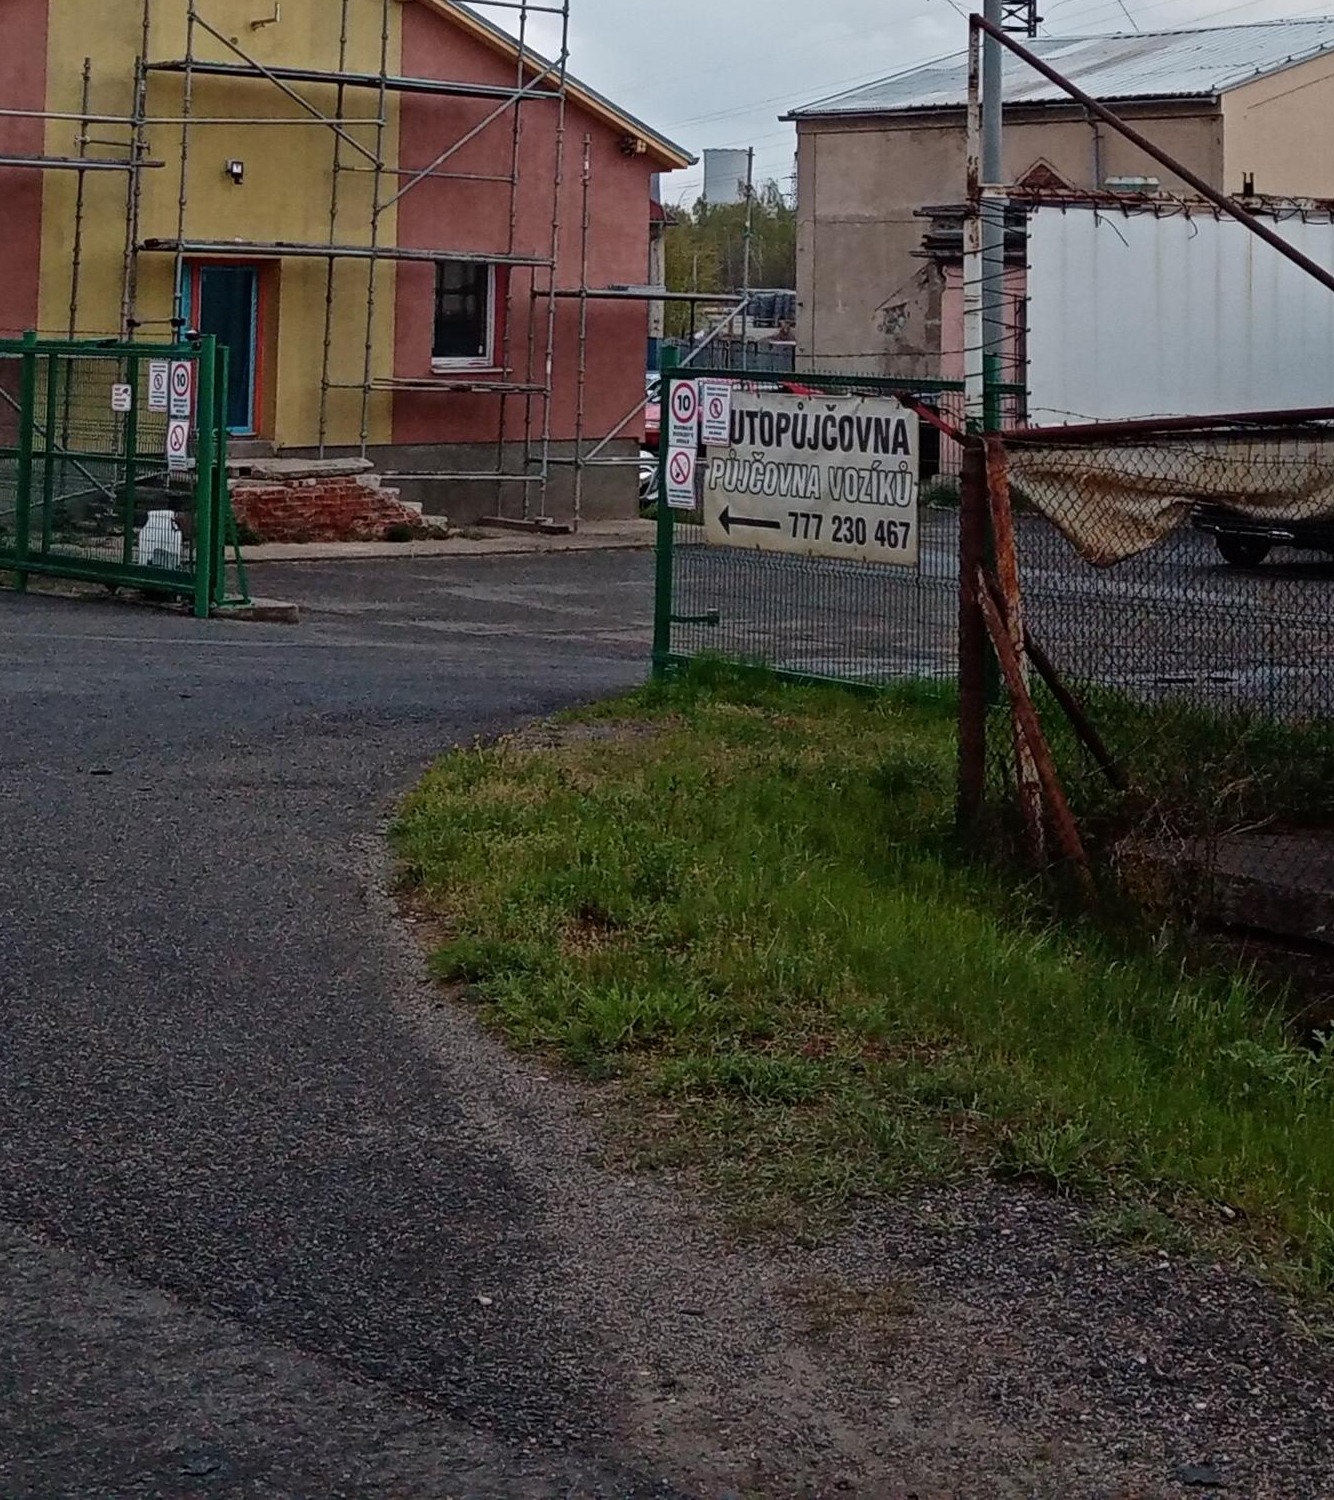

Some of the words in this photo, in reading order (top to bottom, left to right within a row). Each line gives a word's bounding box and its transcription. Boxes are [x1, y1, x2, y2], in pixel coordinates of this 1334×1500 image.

[176, 373, 186, 387] 10
[677, 394, 691, 412] 10
[730, 402, 911, 456] UTOPŮJČOVNA
[709, 448, 821, 500] PŮJČOVNA
[828, 460, 914, 508] VOZÍKŮ
[787, 511, 823, 541] 777
[831, 514, 867, 546] 230
[874, 519, 911, 550] 467
